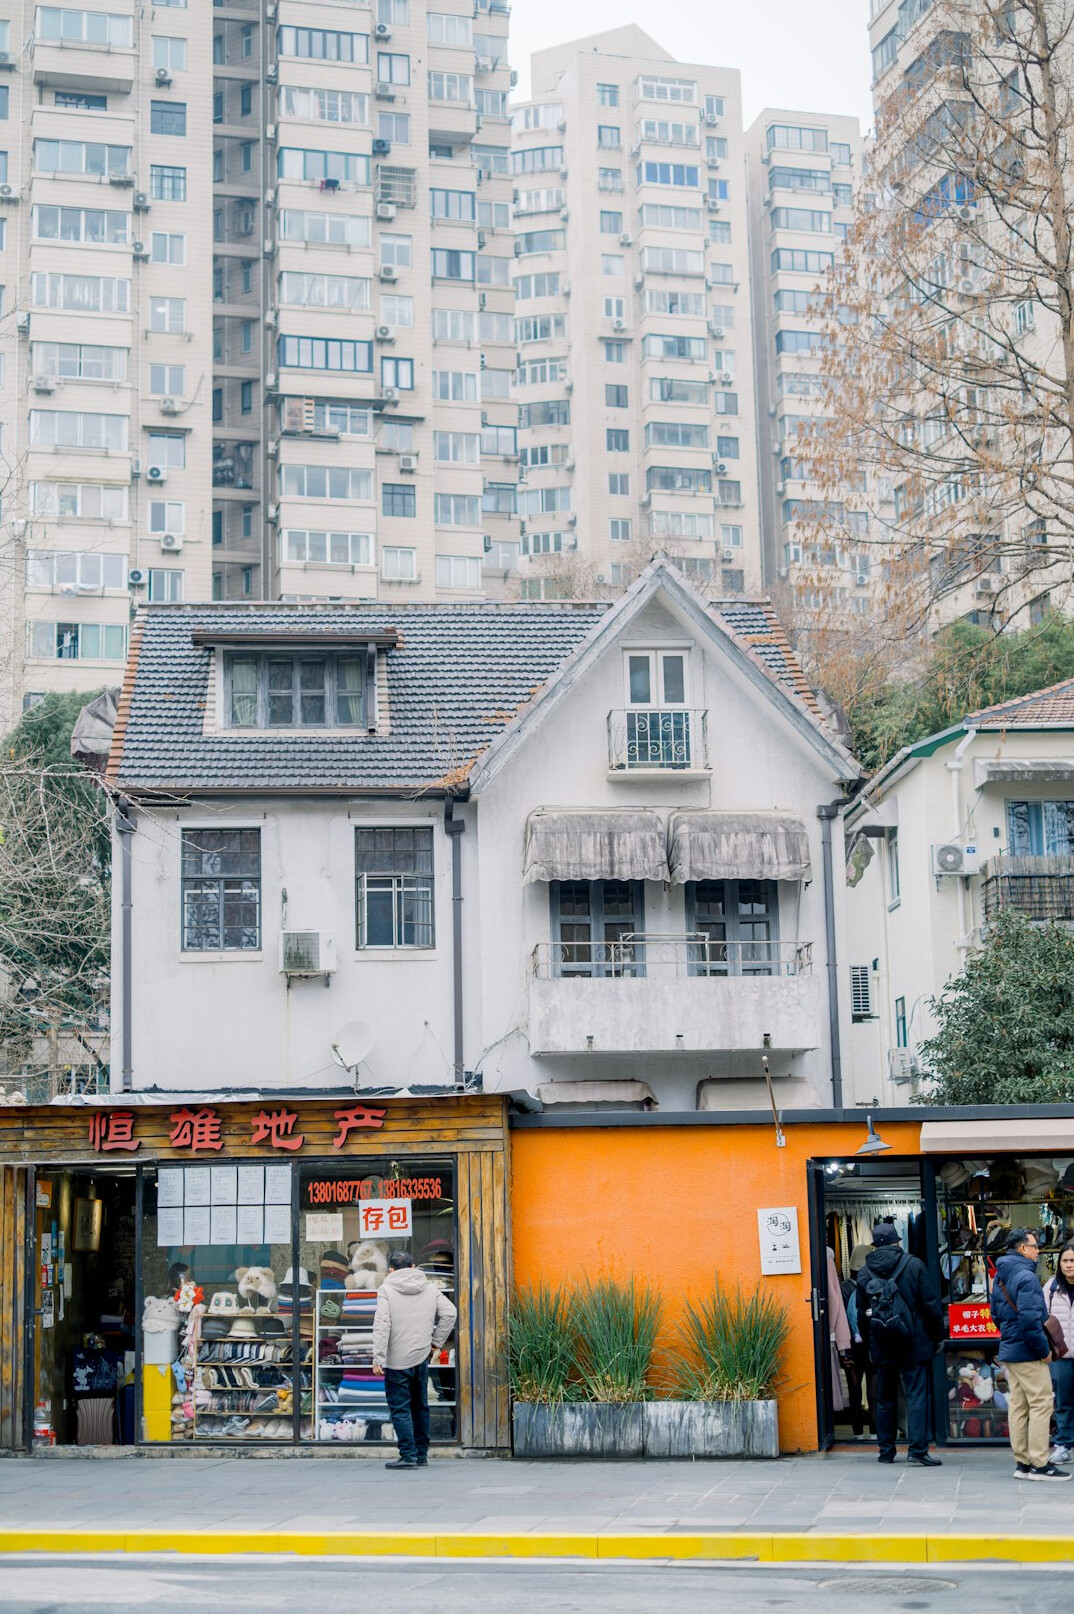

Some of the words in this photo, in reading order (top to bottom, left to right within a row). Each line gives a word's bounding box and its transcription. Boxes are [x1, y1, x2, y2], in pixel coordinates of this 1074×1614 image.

[89, 1105, 387, 1151] 恒雄地产
[308, 1181, 373, 1203] 13801687767
[378, 1178, 442, 1199] 13816335536
[363, 1206, 409, 1232] 存包
